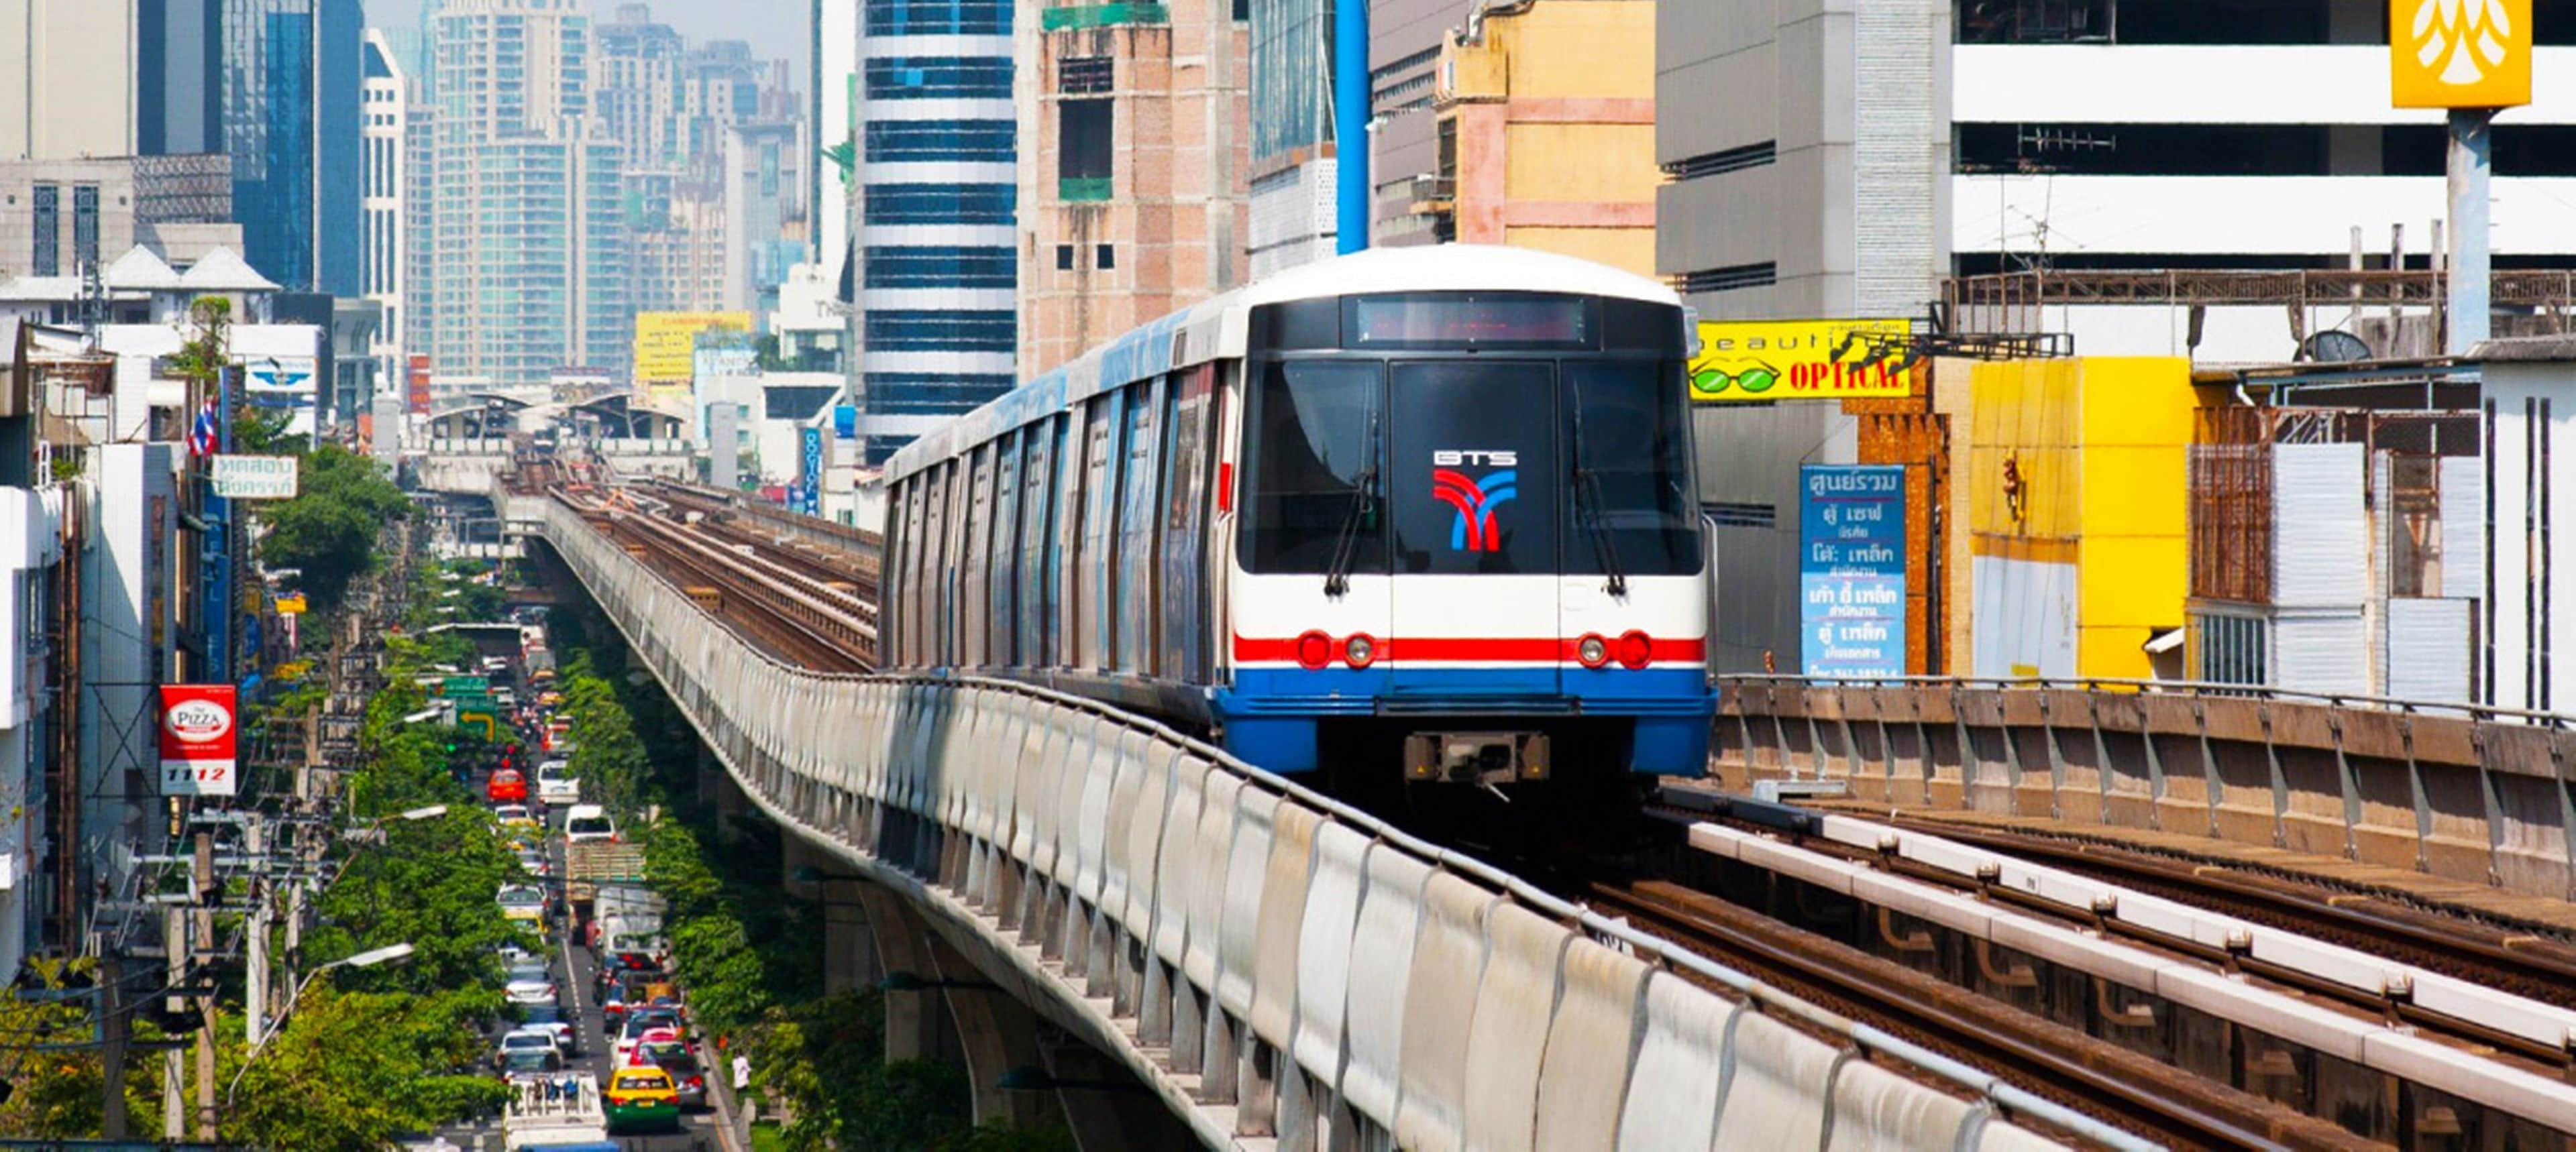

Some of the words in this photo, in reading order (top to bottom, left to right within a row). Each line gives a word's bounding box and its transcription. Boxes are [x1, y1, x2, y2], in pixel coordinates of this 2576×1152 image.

[1790, 359, 1904, 389] OPTICAL
[1434, 451, 1517, 465] BTS
[1810, 469, 1897, 496] ศูนย์รวม
[178, 711, 220, 725] PIZZA
[168, 768, 226, 781] 1112
